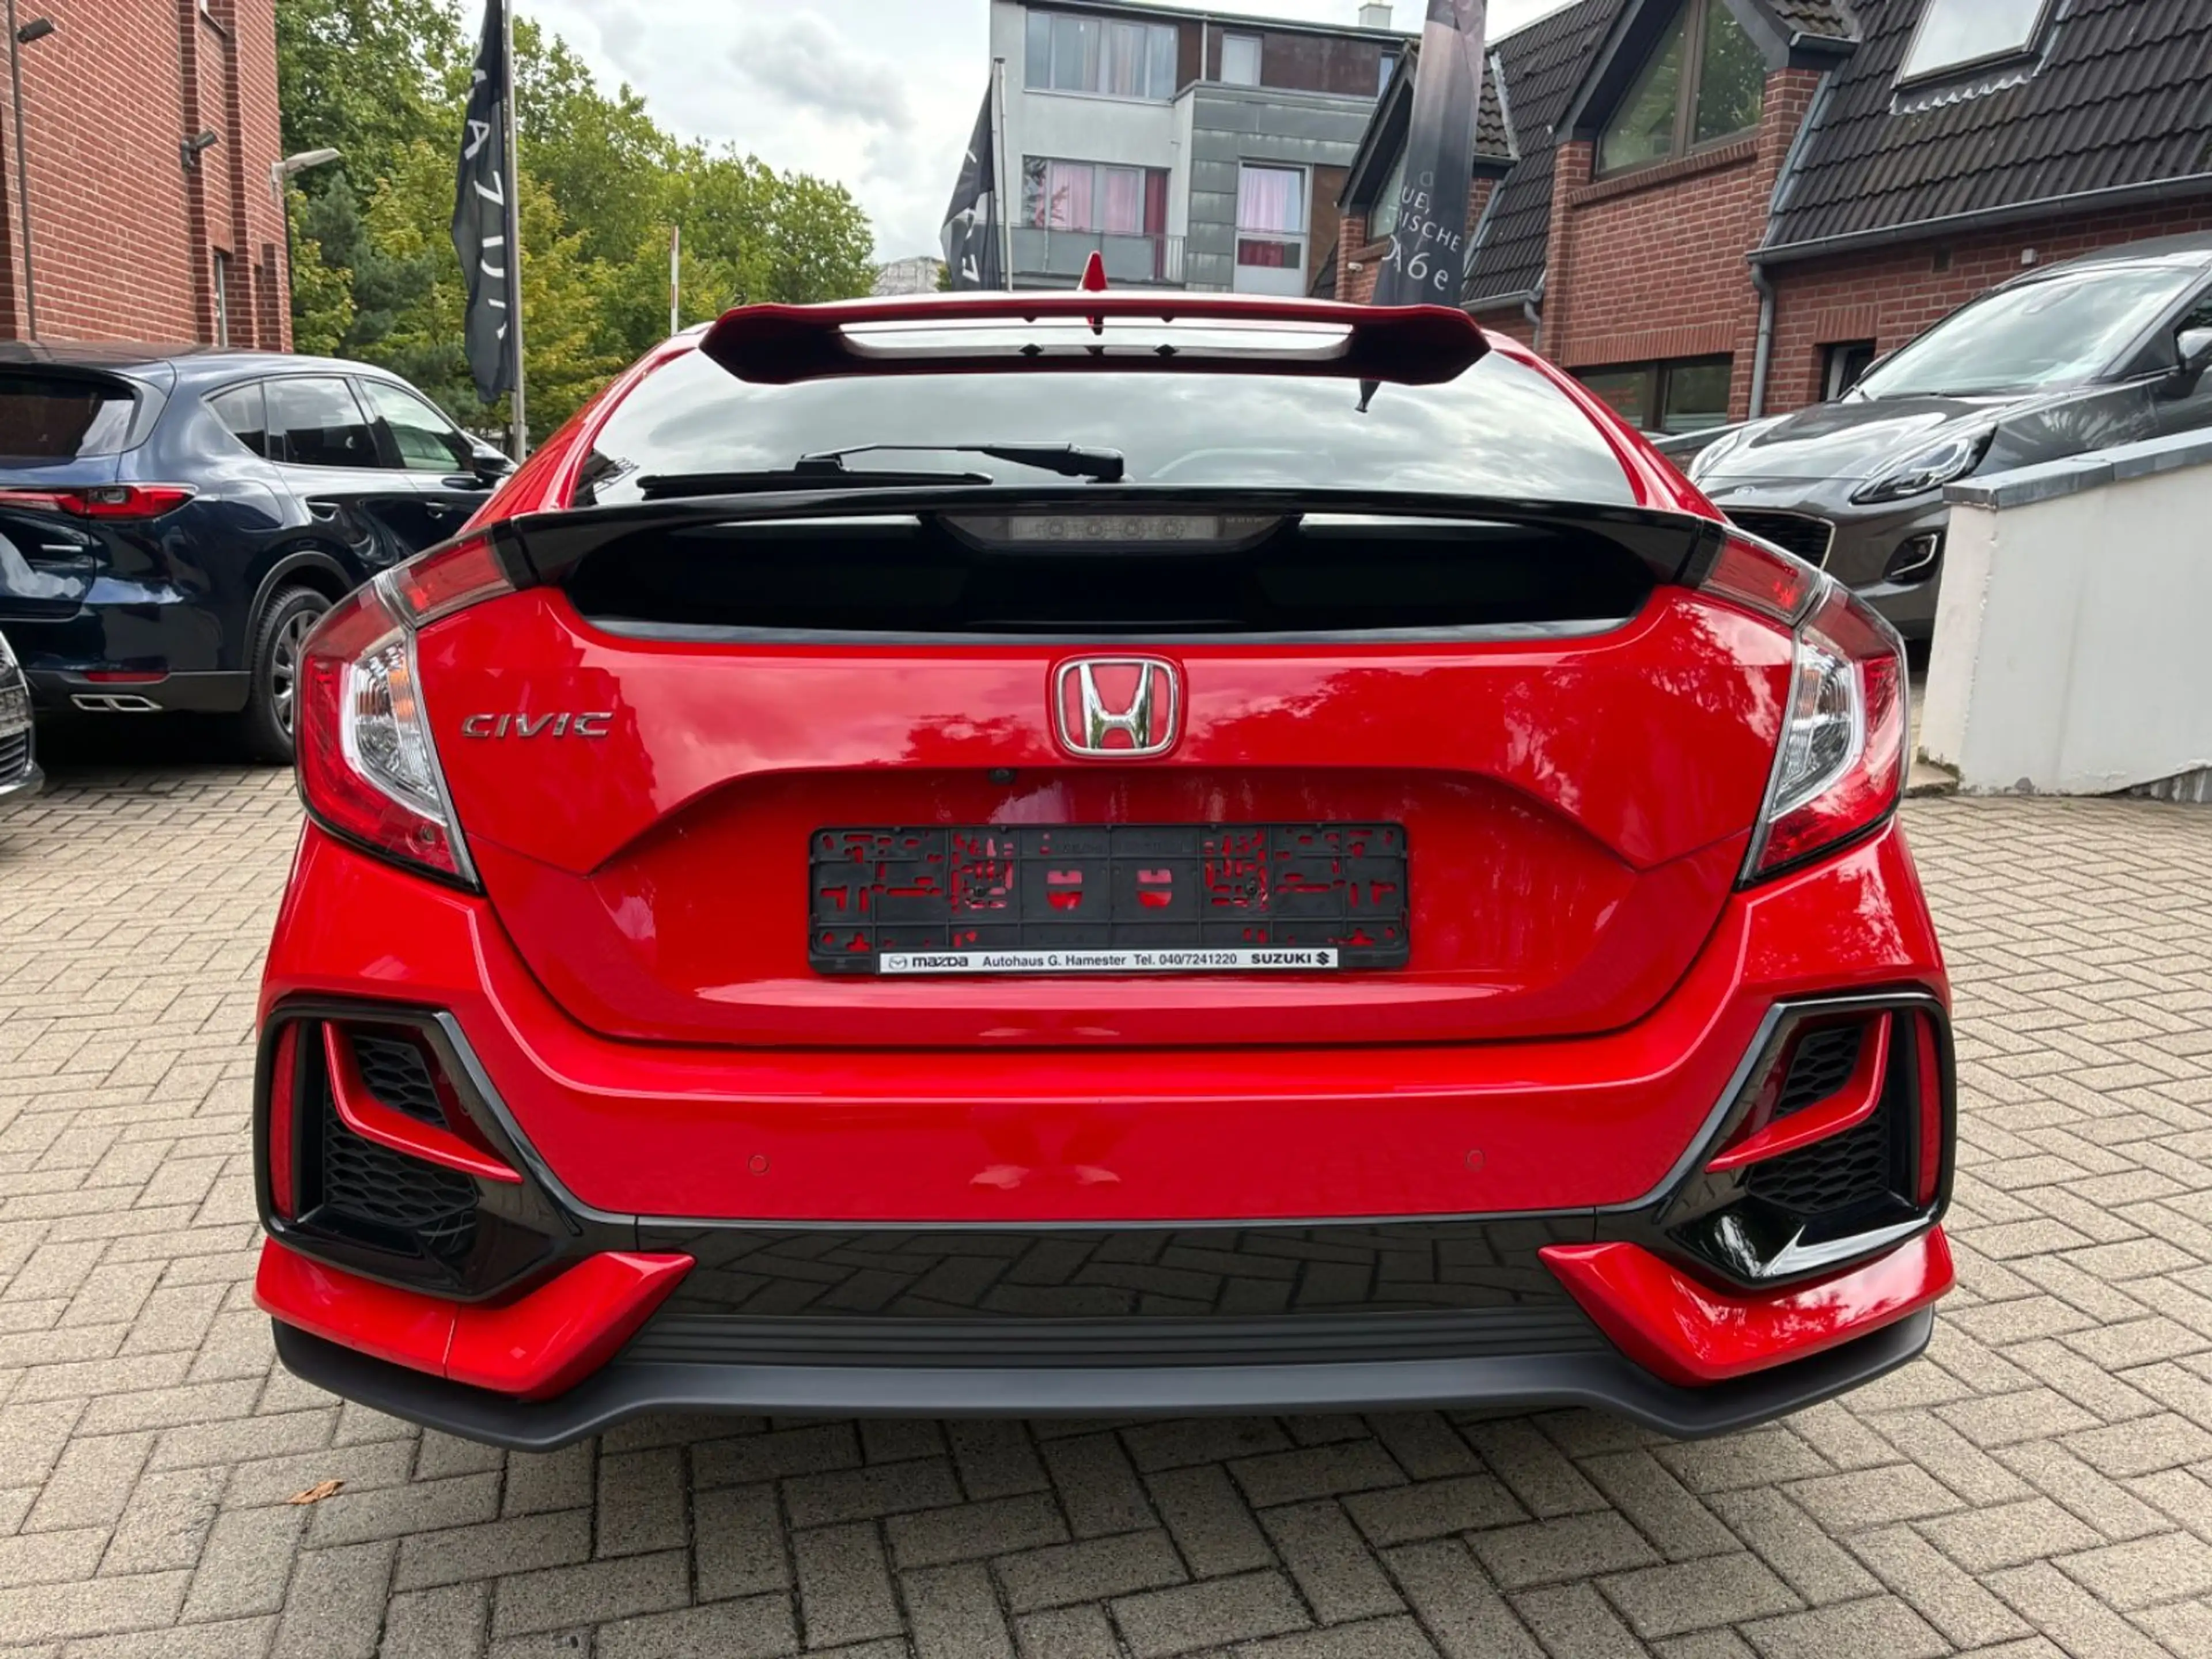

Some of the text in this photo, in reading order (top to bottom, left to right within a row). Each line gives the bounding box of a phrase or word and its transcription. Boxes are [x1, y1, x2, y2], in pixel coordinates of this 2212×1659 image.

[1399, 209, 1461, 252] ISCHE
[461, 712, 614, 737] CIVIC
[982, 955, 1044, 967] Autohaus
[1047, 955, 1062, 967] G.
[1066, 953, 1127, 967] Hamester
[1134, 953, 1155, 965] Tel.
[1158, 953, 1237, 966] 040/7241220
[1251, 953, 1312, 964] SUZUKI
